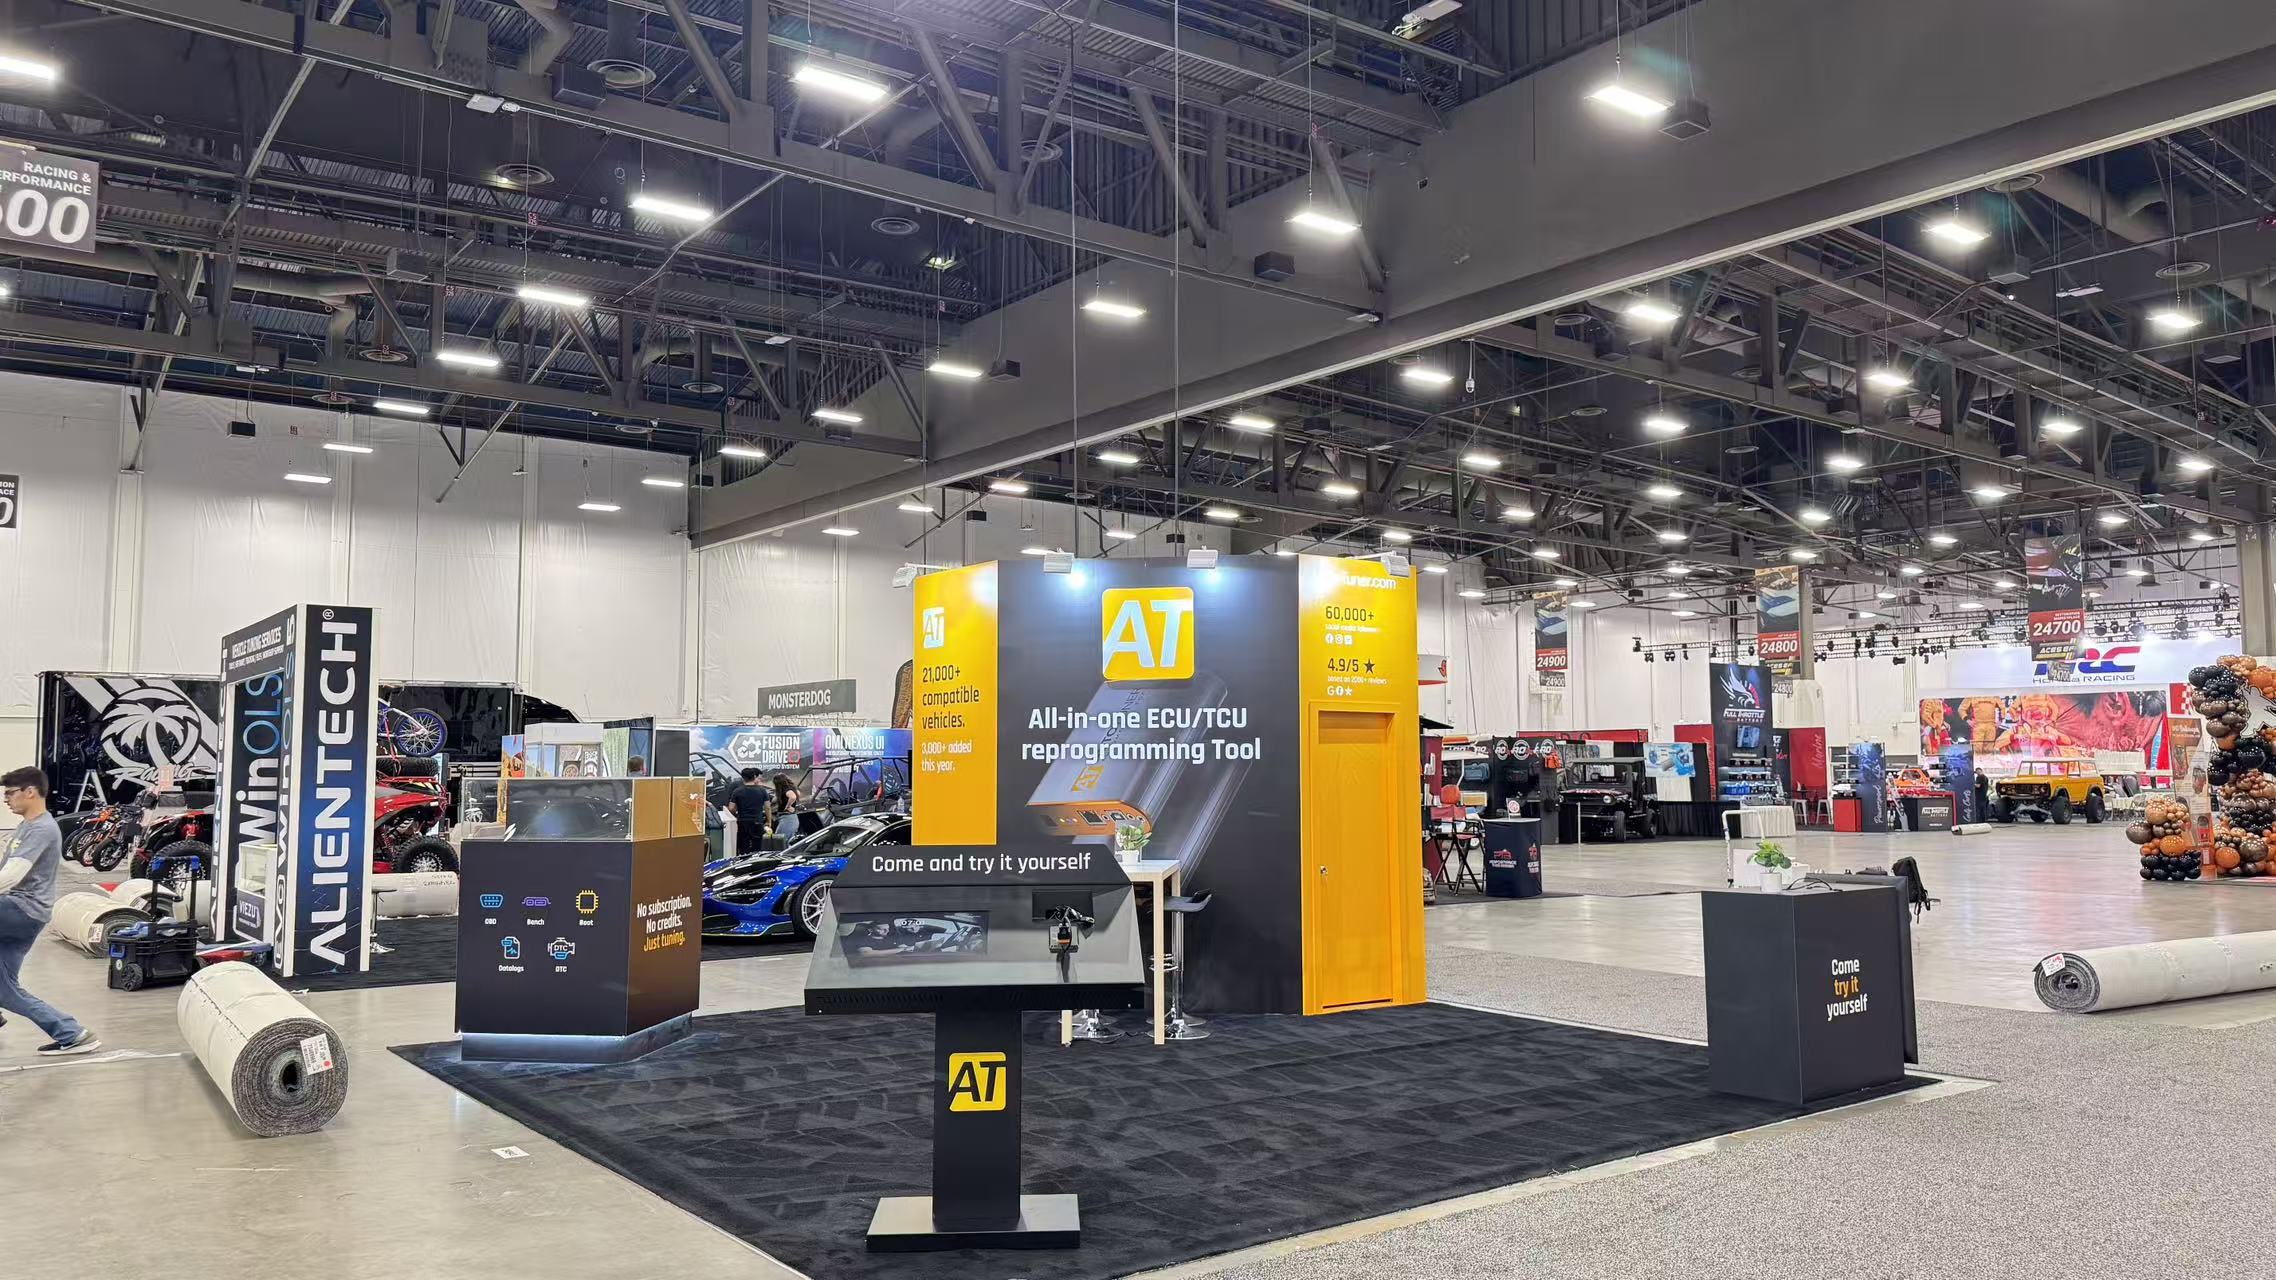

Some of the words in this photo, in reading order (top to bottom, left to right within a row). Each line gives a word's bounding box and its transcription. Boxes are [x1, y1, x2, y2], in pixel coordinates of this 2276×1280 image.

[24, 161, 78, 180] RACING
[81, 172, 92, 183] &
[1325, 606, 1374, 622] 60,000+
[1102, 599, 1194, 673] AT
[2033, 619, 2081, 637] 24700
[1760, 640, 1798, 654] 24800
[1327, 658, 1359, 673] 4.9/5
[1537, 655, 1566, 668] 24900
[922, 665, 961, 684] 21,000+
[2084, 674, 2136, 683] RACING
[768, 689, 832, 710] MONSTERDOG
[922, 685, 980, 708] compatible
[922, 712, 966, 730] vehicles.
[1028, 706, 1140, 729] All-in-one
[1147, 707, 1247, 729] ECU/TCU
[762, 735, 800, 750] FUSION
[875, 735, 885, 750] UI
[948, 740, 972, 753] added
[1021, 738, 1205, 764] reprogramming
[1212, 737, 1261, 760] Tool
[921, 759, 936, 772] this
[936, 760, 956, 774] year.
[872, 856, 924, 872] Come
[929, 854, 963, 871] and
[970, 854, 995, 874] try
[1000, 853, 1012, 871] it
[1018, 853, 1091, 874] yourself
[637, 903, 648, 918] No
[648, 894, 692, 916] subscription.
[526, 918, 545, 926] Bench
[646, 919, 656, 934] No
[657, 912, 683, 931] credits.
[643, 934, 660, 952] Just
[661, 929, 686, 947] tuning.
[498, 965, 524, 973] Datalogs
[1831, 959, 1860, 975] Come
[1834, 979, 1849, 998] try
[1850, 975, 1859, 993] it
[1826, 993, 1868, 1021] yourself
[947, 1060, 1006, 1108] AT
